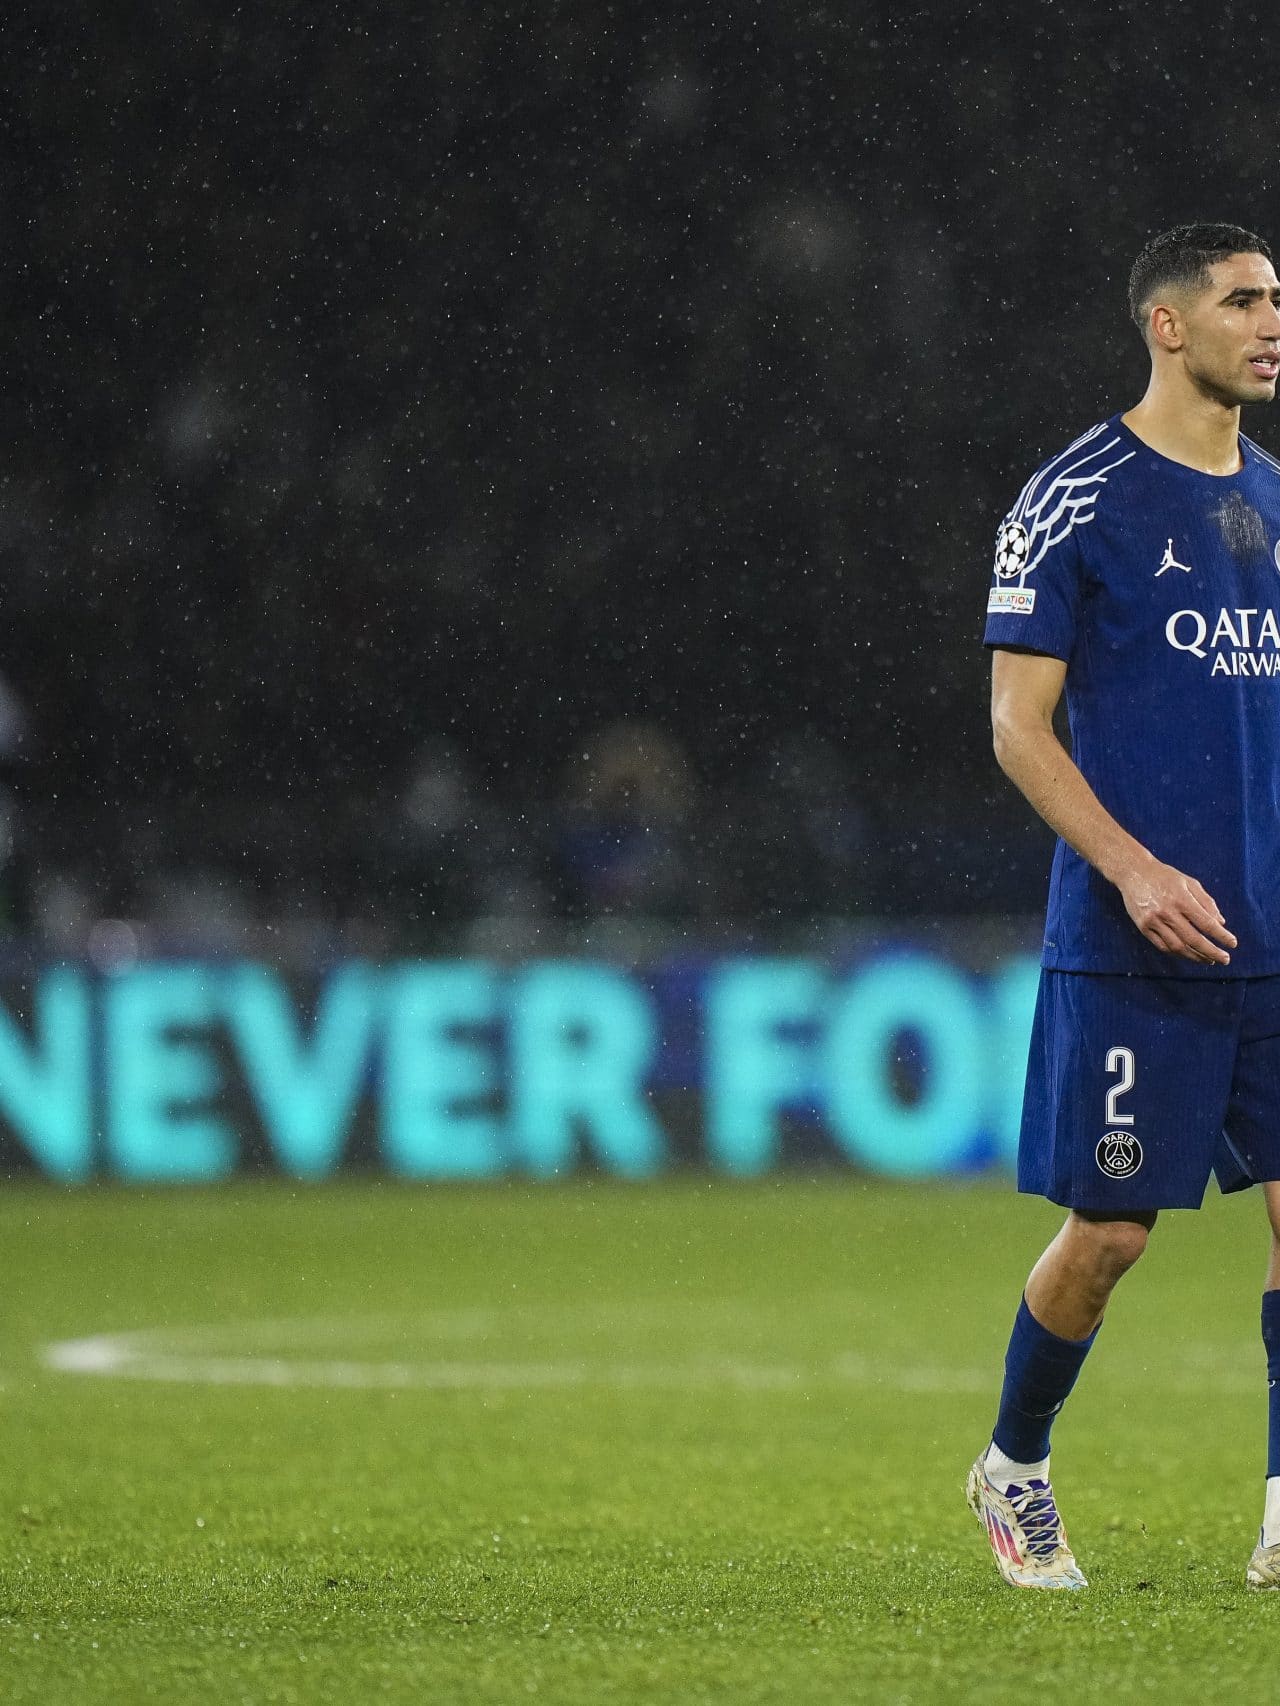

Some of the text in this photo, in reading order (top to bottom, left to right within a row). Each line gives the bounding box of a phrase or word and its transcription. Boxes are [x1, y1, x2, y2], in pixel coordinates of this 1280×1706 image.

[0, 958, 666, 1180] NEVER
[1105, 1046, 1135, 1126] 2
[1103, 1133, 1135, 1146] PARIS
